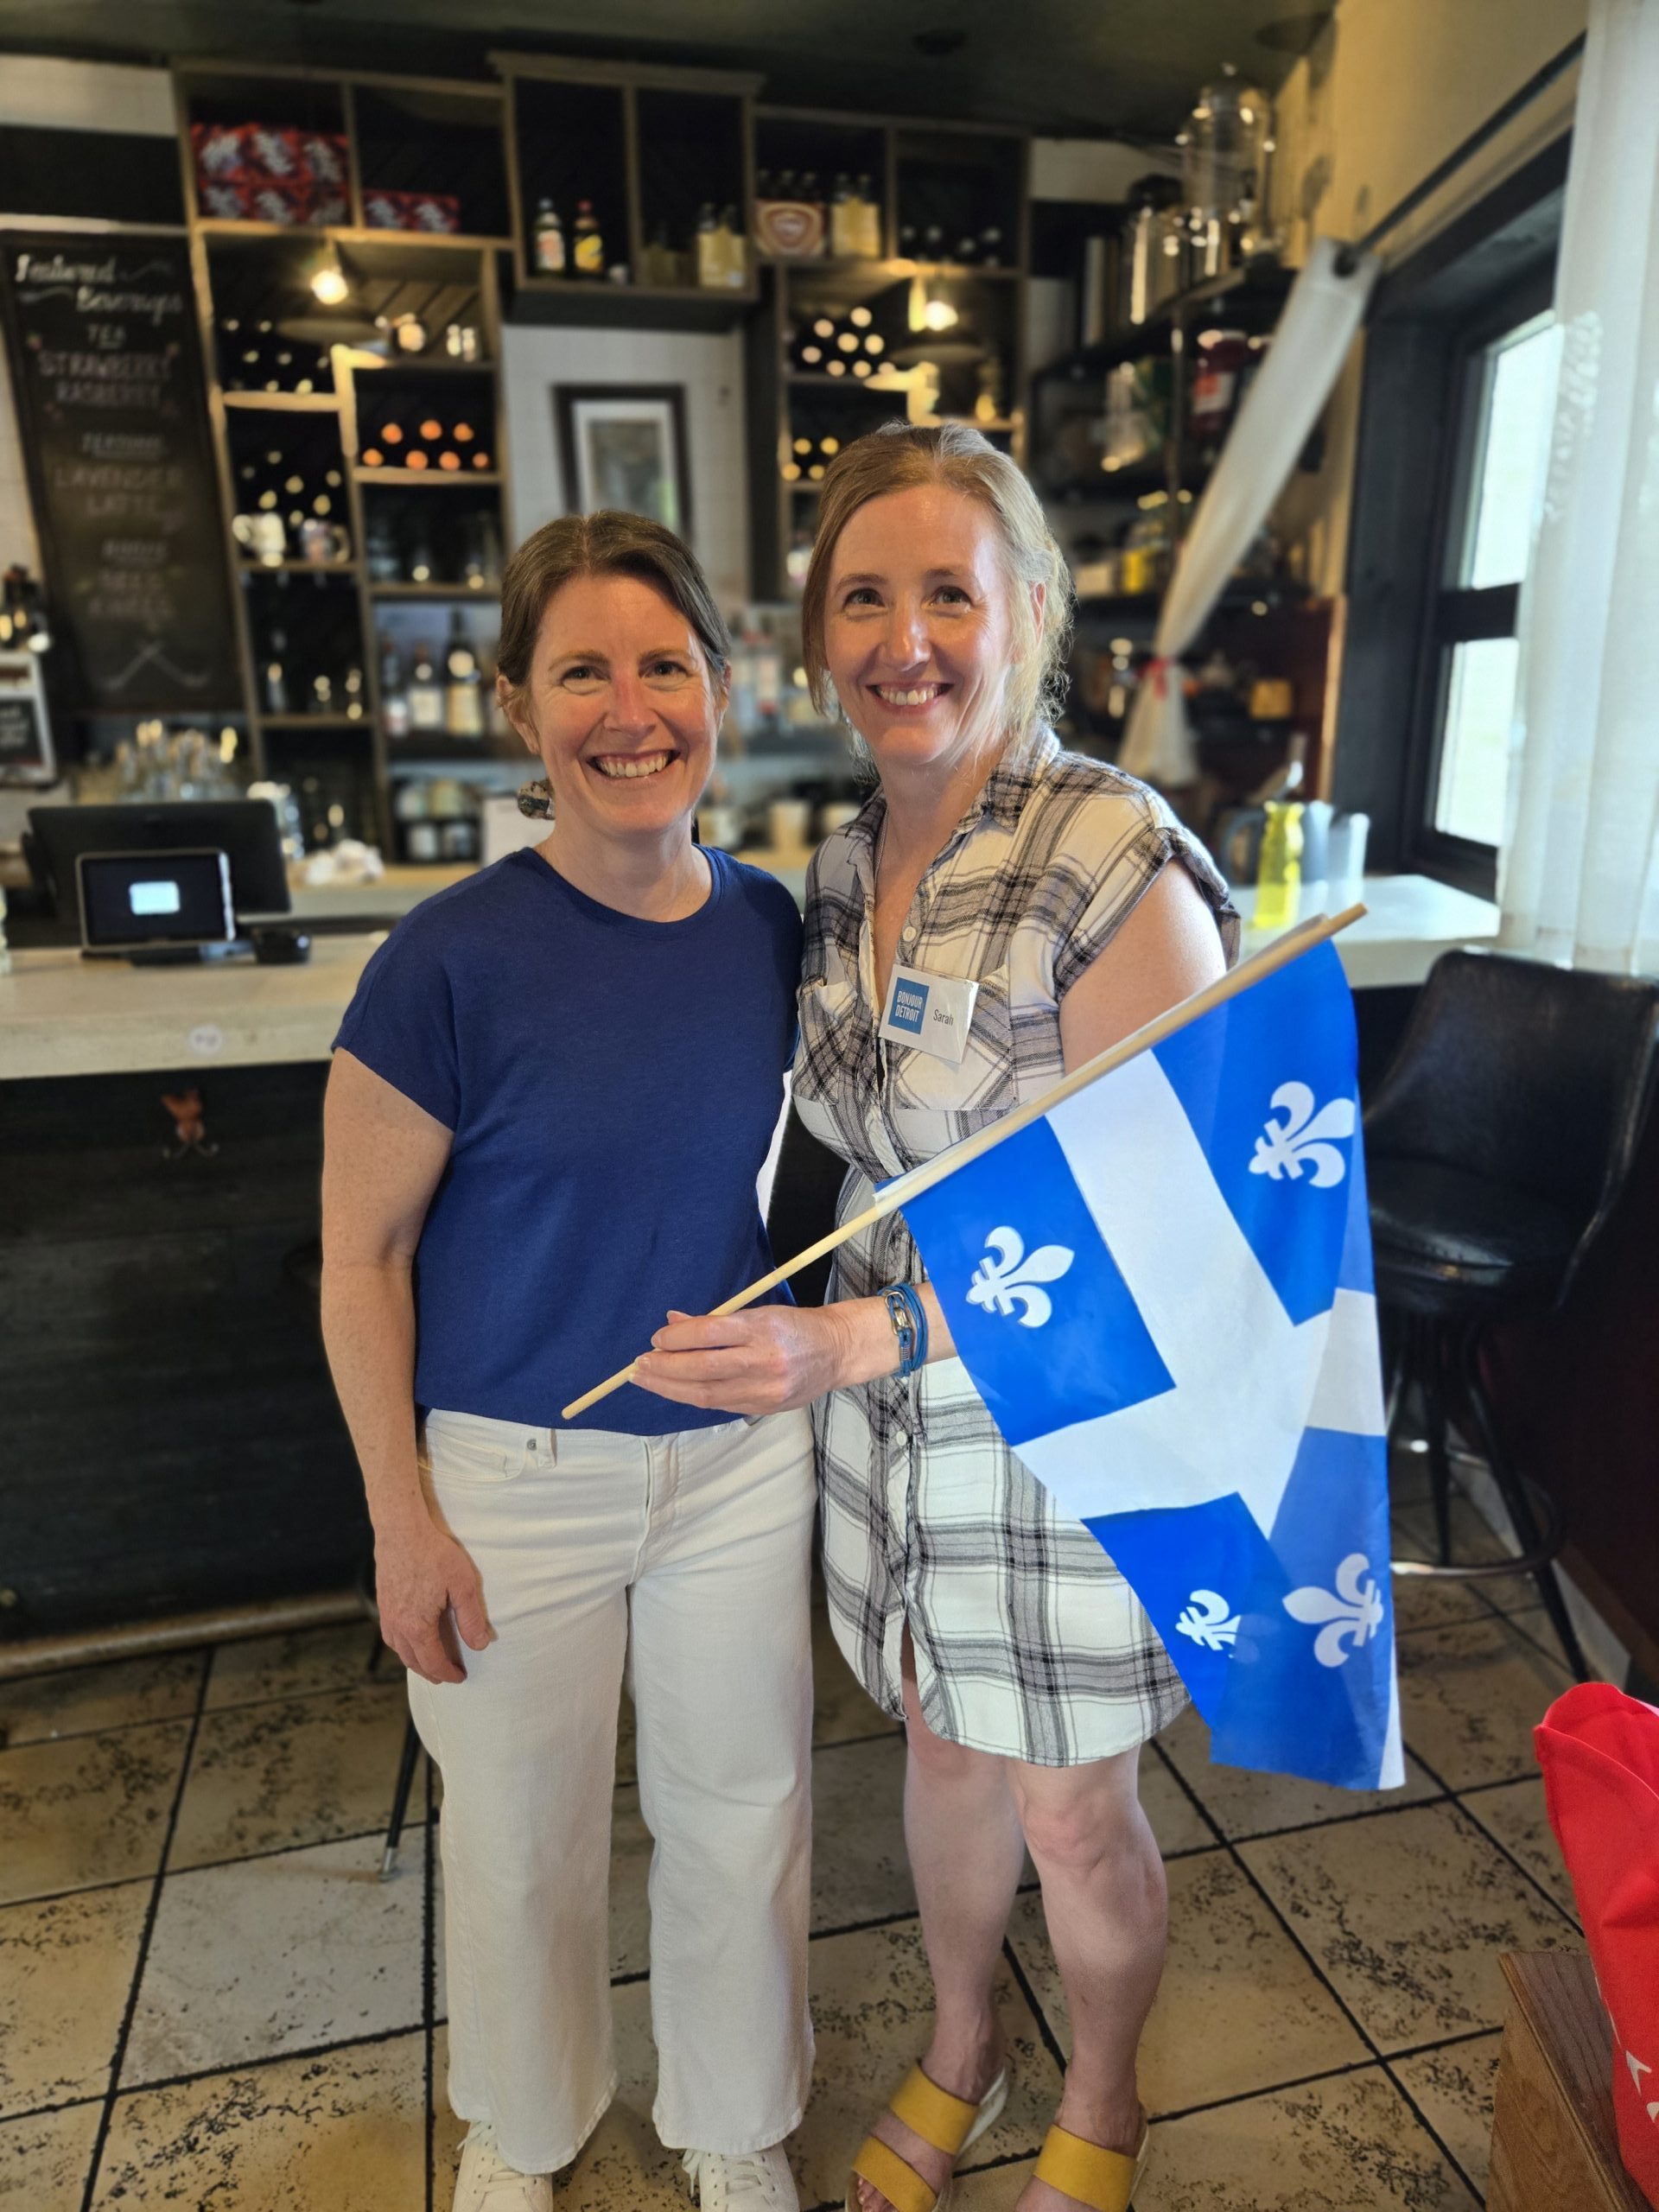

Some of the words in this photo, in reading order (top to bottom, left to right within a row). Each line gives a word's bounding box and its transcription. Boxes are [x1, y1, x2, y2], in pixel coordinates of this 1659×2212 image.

[897, 990, 923, 1009] BONJOUR
[895, 1004, 919, 1022] DETROIT
[933, 1009, 954, 1026] Sarah
